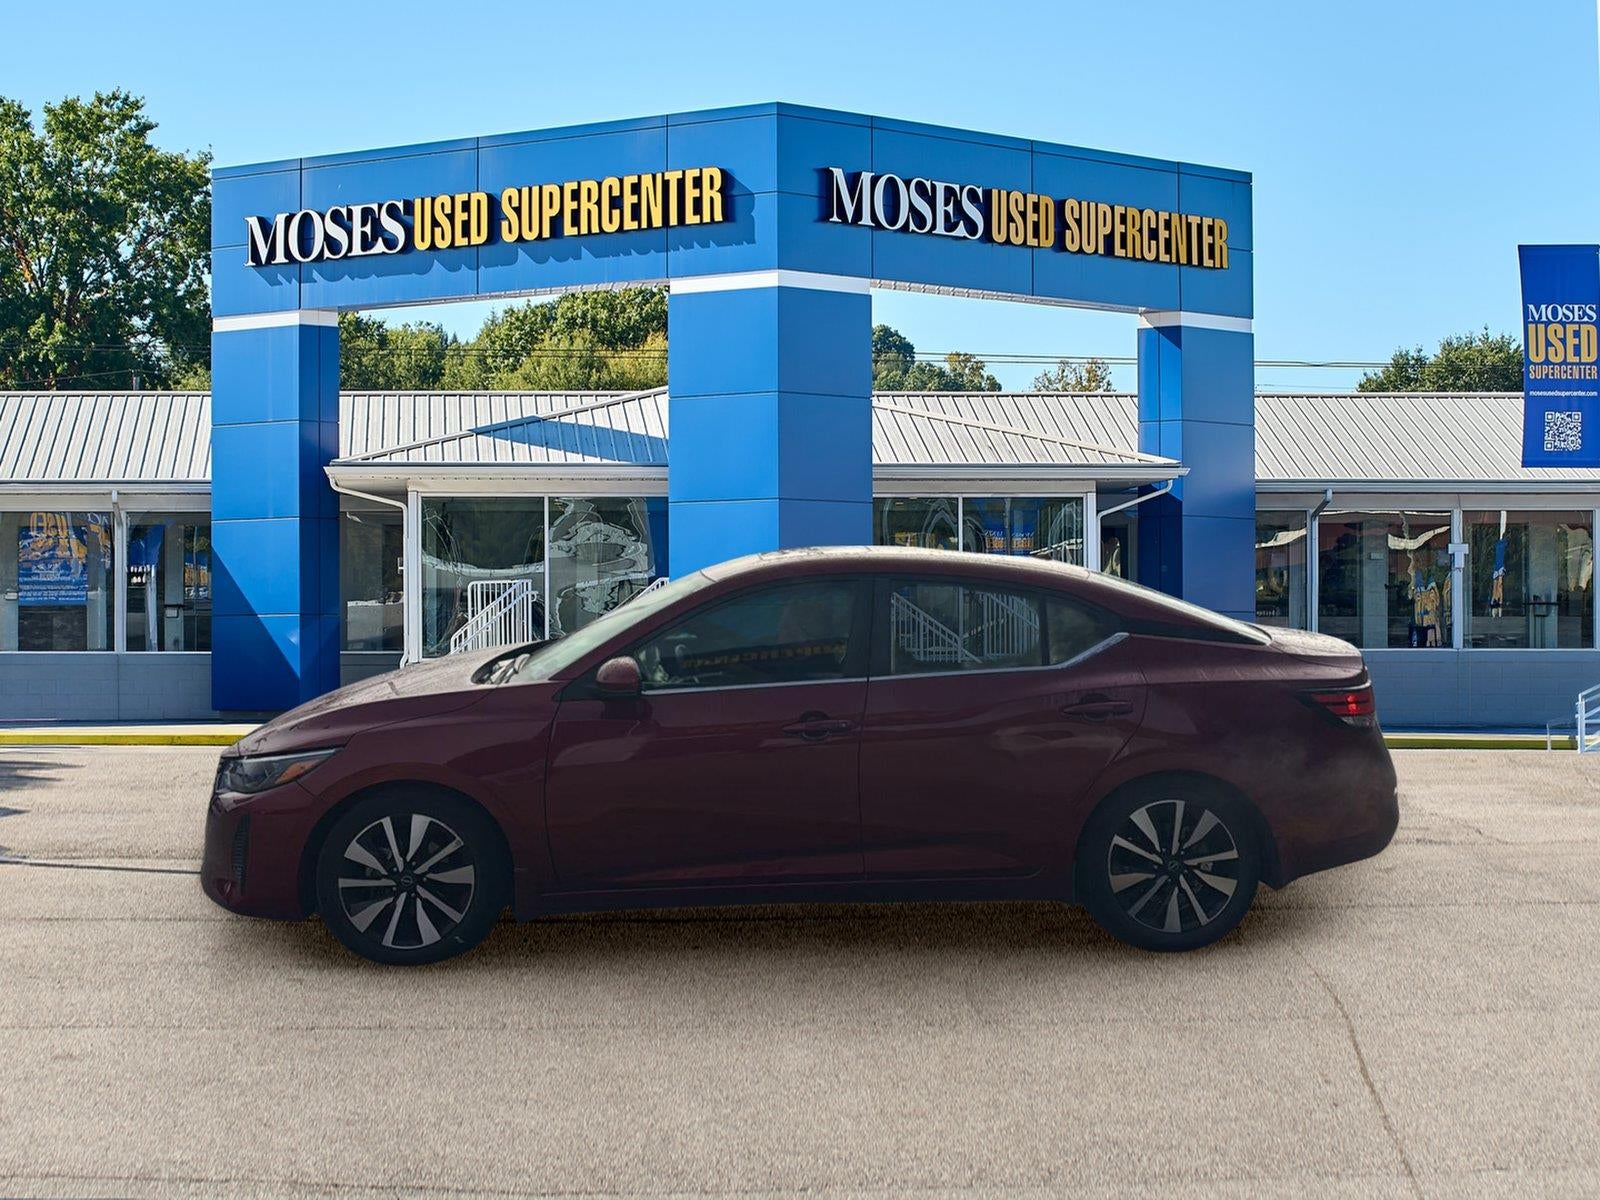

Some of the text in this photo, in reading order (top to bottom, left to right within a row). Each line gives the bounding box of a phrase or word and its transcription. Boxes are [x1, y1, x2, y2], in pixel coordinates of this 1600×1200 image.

[244, 166, 724, 267] MOSES USED SUPERCENTER
[829, 167, 1229, 269] MOSES USED SUPERCENTER
[1528, 304, 1597, 322] MOSES
[1528, 324, 1598, 363] USED
[1529, 365, 1598, 379] SUPERCENTER
